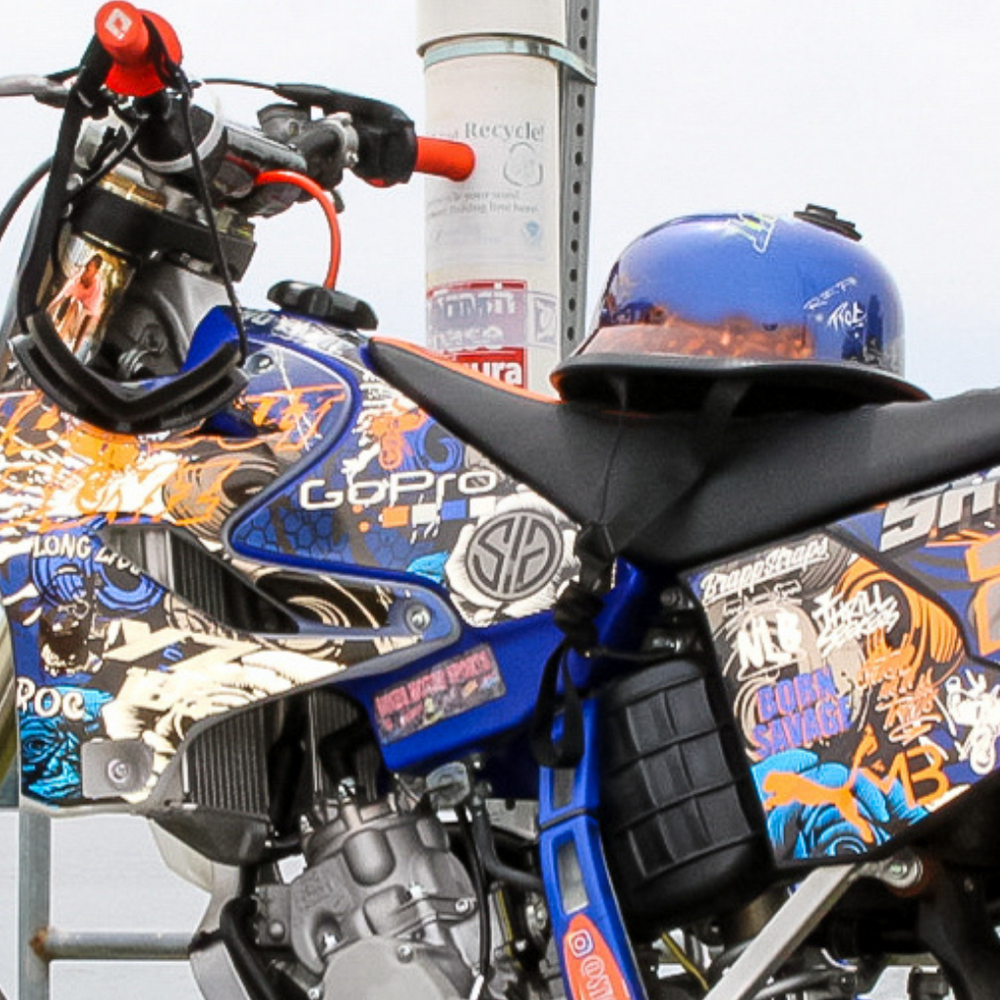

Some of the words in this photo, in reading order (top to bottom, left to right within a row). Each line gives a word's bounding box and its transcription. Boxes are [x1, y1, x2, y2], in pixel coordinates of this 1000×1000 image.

[463, 361, 523, 387] ura
[300, 470, 497, 511] GoPro
[32, 533, 91, 559] LONG
[756, 666, 838, 722] BORN
[752, 696, 852, 760] SAVAGE
